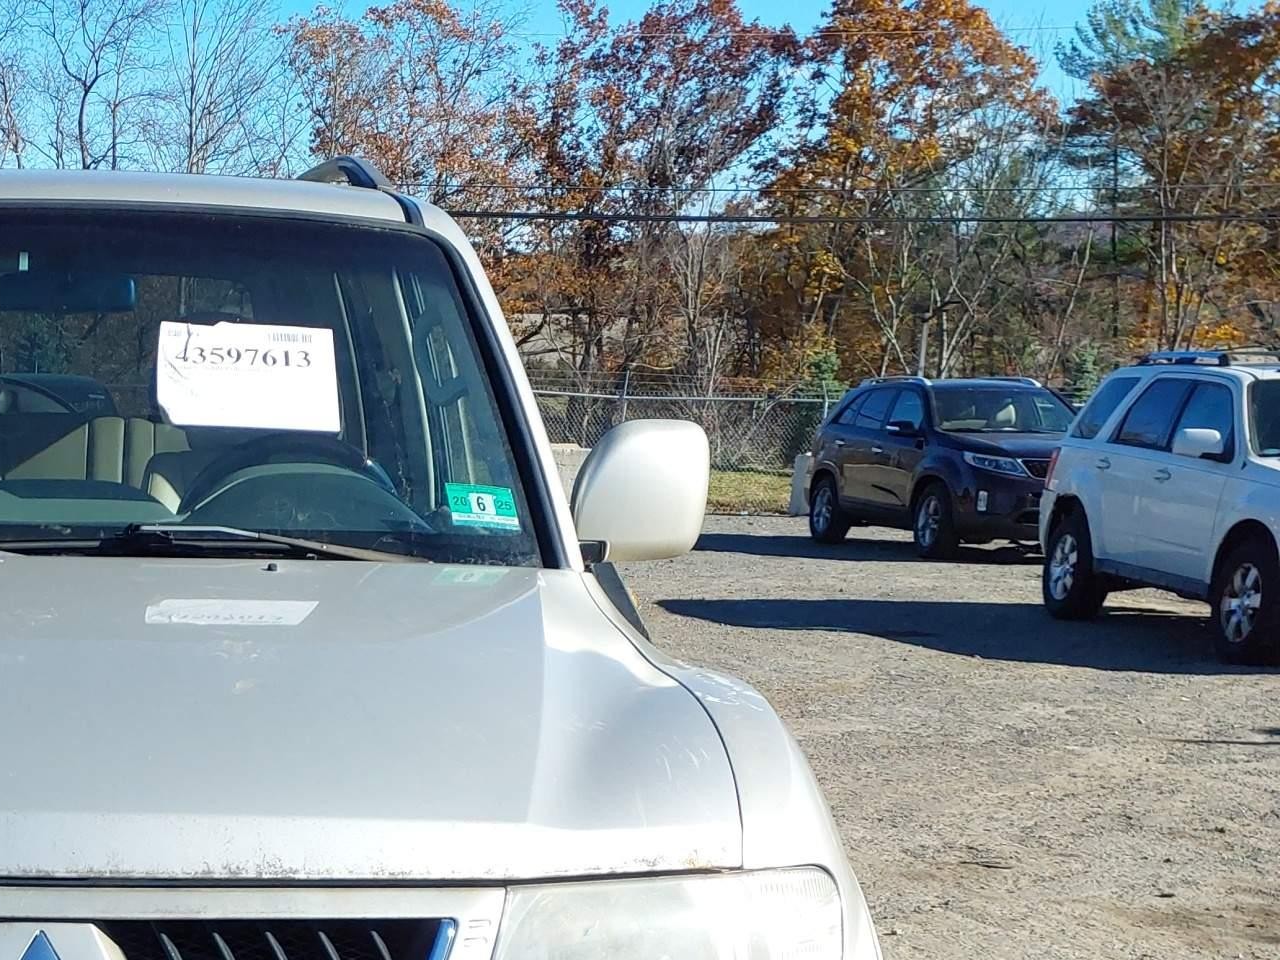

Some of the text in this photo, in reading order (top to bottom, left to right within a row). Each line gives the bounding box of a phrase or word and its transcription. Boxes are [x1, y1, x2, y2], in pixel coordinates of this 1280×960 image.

[175, 346, 312, 368] 43597613
[452, 496, 512, 512] 20 6 25
